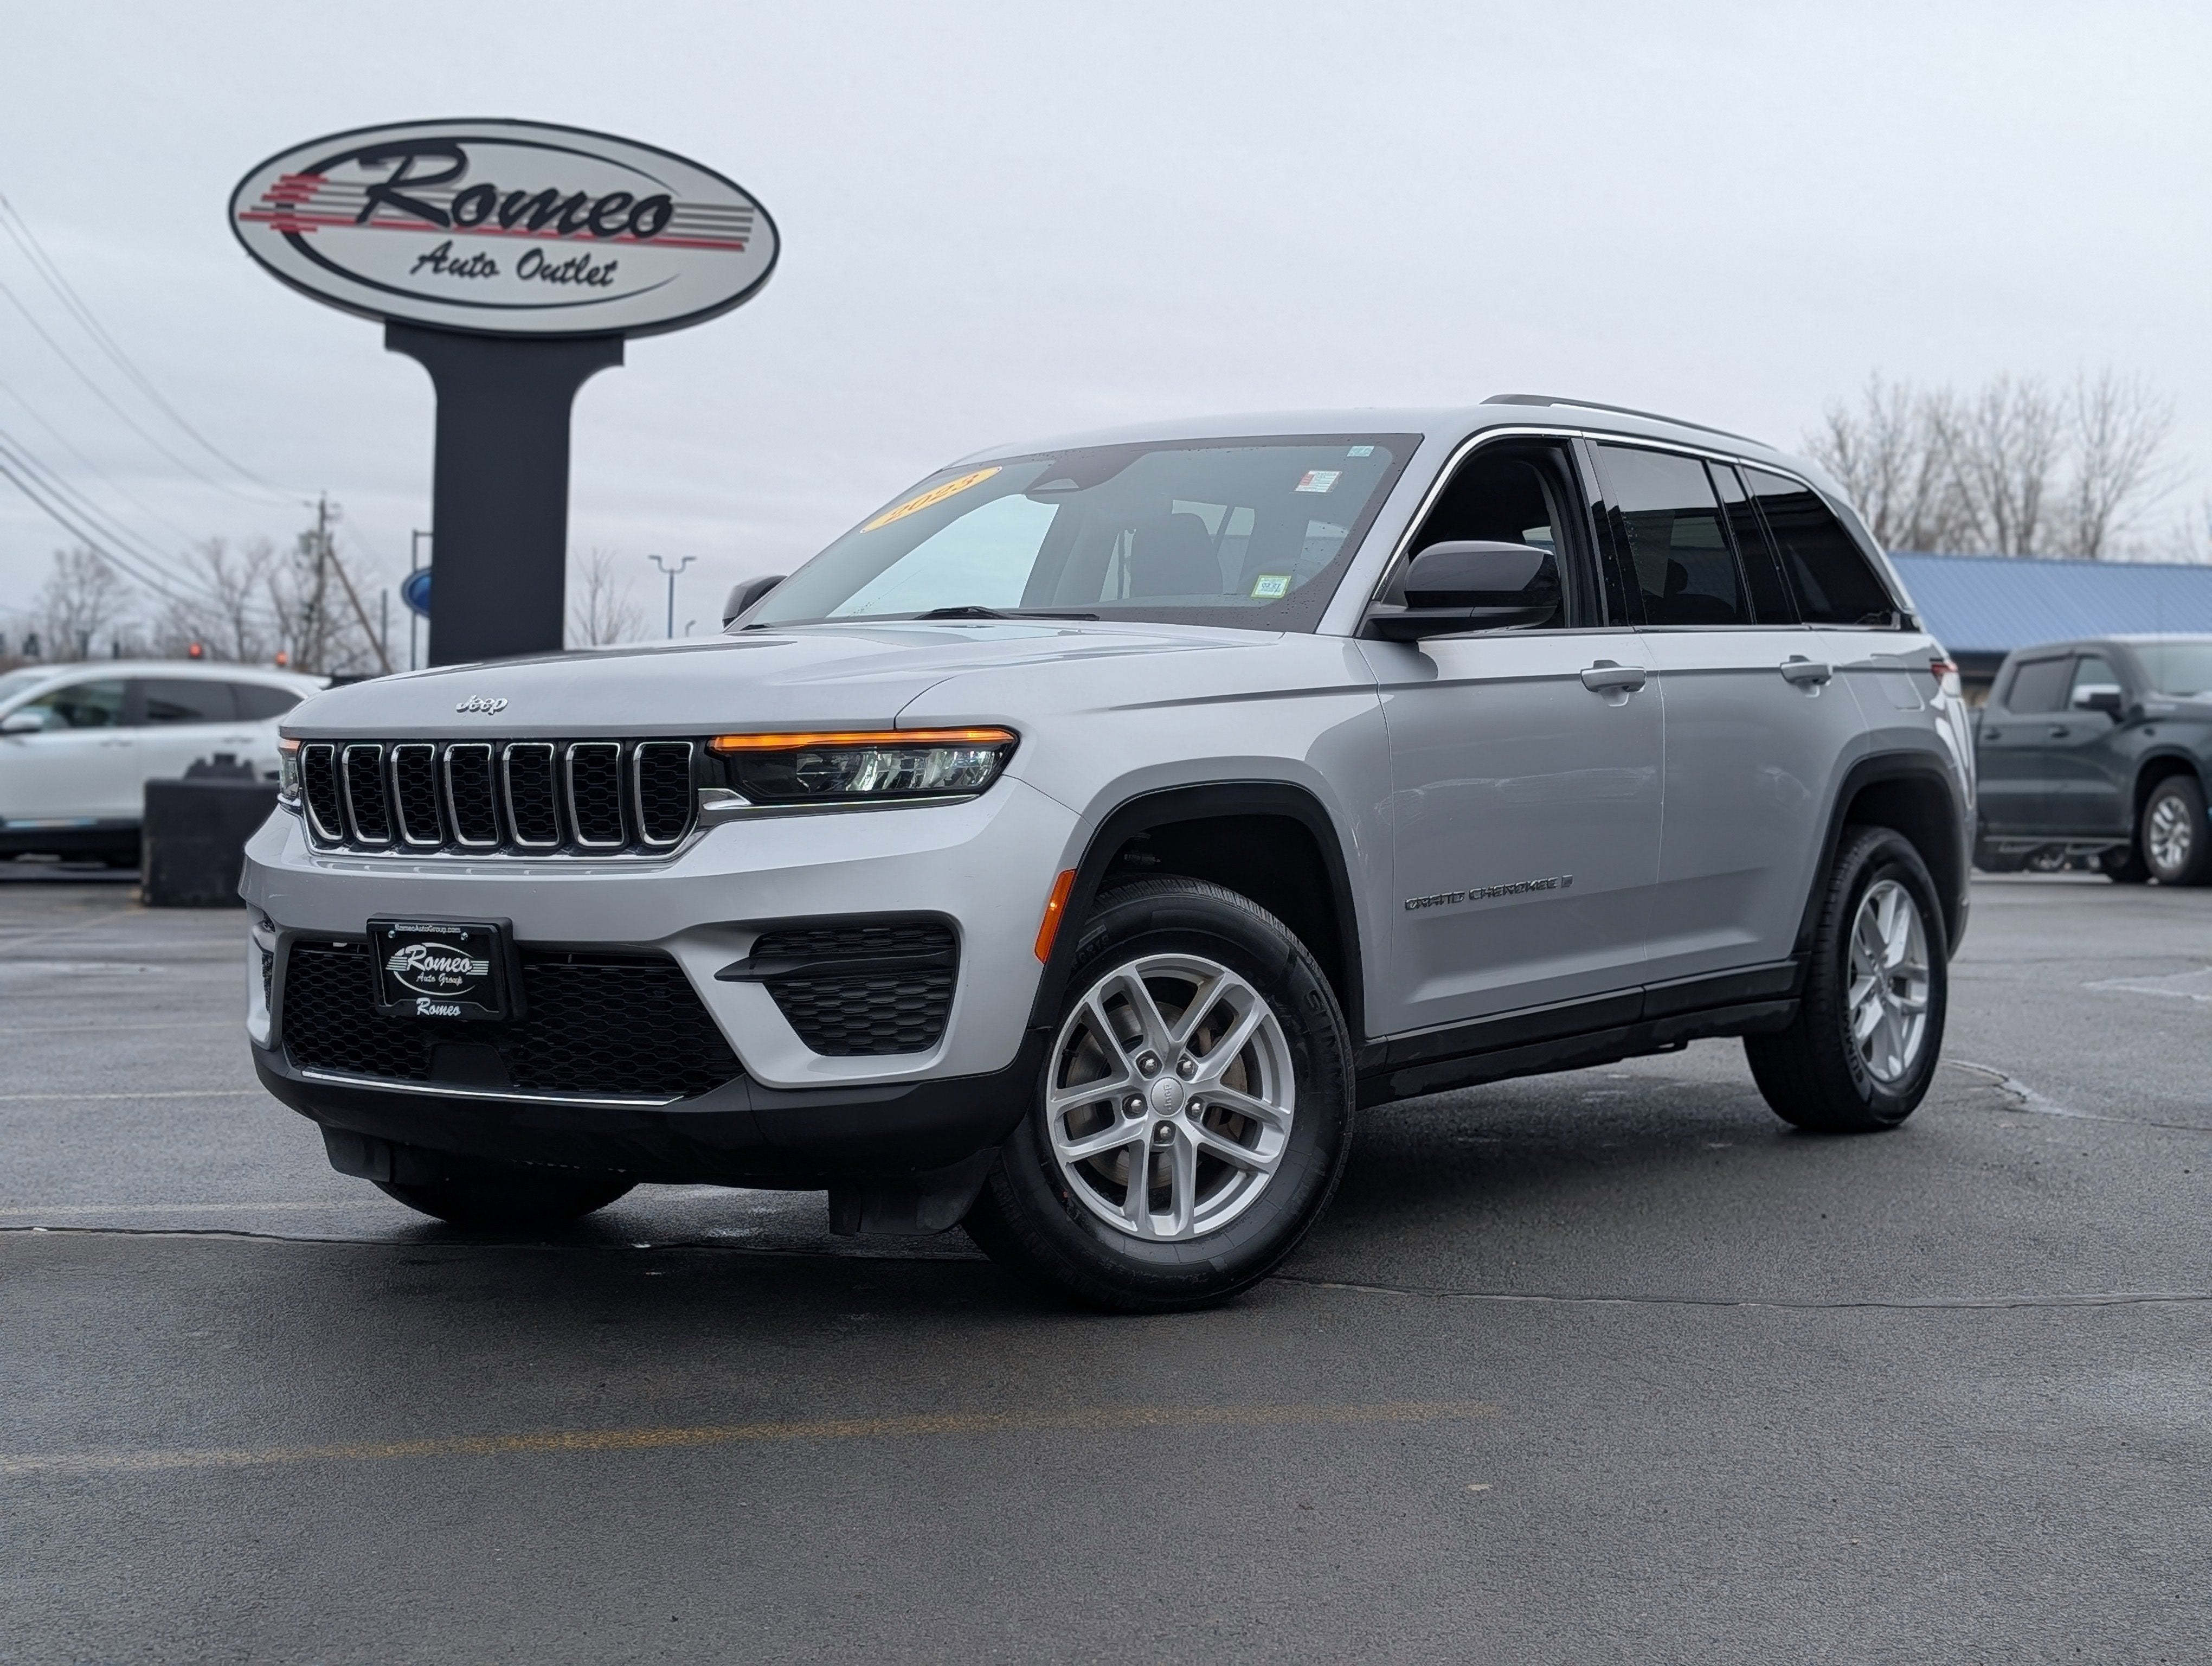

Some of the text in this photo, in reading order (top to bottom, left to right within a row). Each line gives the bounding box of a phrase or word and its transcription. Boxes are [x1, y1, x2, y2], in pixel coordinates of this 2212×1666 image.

[356, 141, 674, 239] Romeo
[409, 239, 618, 288] Auto Outlet
[455, 694, 509, 715] Jeep
[1405, 876, 1559, 911] GRAND CHEROKEE
[395, 924, 461, 934] RomeoAutoGroup.com
[404, 944, 473, 973] Romeo
[416, 972, 463, 986] Auto Group
[416, 997, 461, 1016] Romeo
